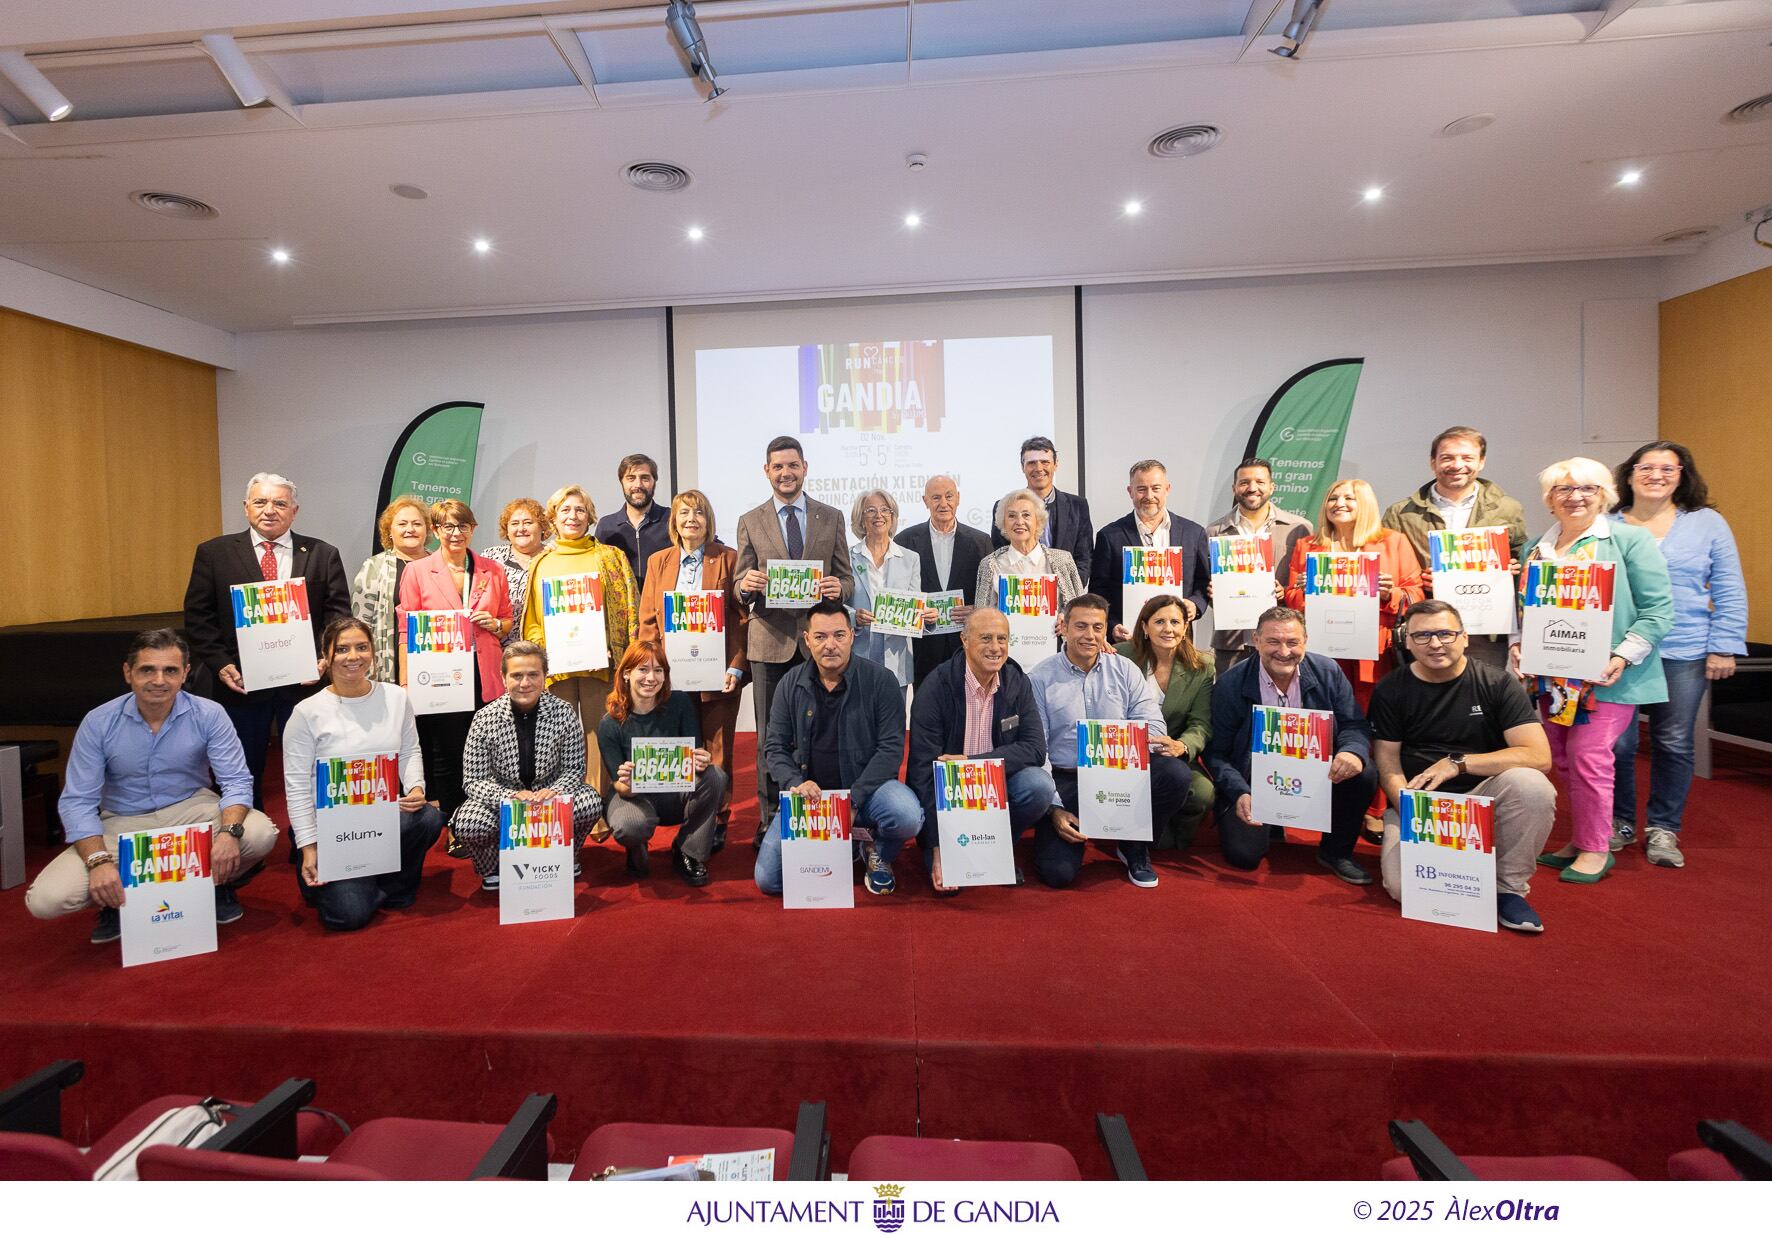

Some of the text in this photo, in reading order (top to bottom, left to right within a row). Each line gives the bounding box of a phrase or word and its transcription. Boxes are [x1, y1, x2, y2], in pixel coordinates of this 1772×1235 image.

[817, 380, 922, 413] GANDIA
[1269, 457, 1325, 469] Tenemos
[804, 473, 888, 492] ESENTACIÓN
[893, 476, 905, 489] XI
[1285, 472, 1312, 482] gran
[411, 480, 462, 495] Tenemos
[1274, 483, 1309, 493] amino
[1271, 496, 1283, 504] or
[1217, 552, 1264, 567] GANDIA
[1440, 548, 1498, 563] GANDIA
[1129, 565, 1173, 578] GANDIA
[1313, 573, 1368, 588] GANDIA
[549, 592, 594, 608] GANDIA
[1535, 584, 1600, 600] GANDIA
[1005, 594, 1049, 608] GANDIA
[242, 600, 298, 619] GANDIA
[671, 611, 716, 625] GANDIA
[415, 630, 464, 646] GANDIA
[1549, 629, 1587, 640] AIMAR
[1261, 730, 1320, 750] GANDIA
[1085, 743, 1139, 759] GANDIA
[326, 777, 387, 799] GANDIA
[944, 783, 997, 801] GANDIA
[508, 820, 562, 840] GANDIA
[788, 815, 841, 831] GANDIA
[1410, 816, 1480, 841] GANDIA
[335, 829, 377, 843] sklum
[130, 851, 201, 877] GANDIA
[532, 864, 561, 873] VICKY
[1415, 864, 1480, 883] RB INFORMATICA
